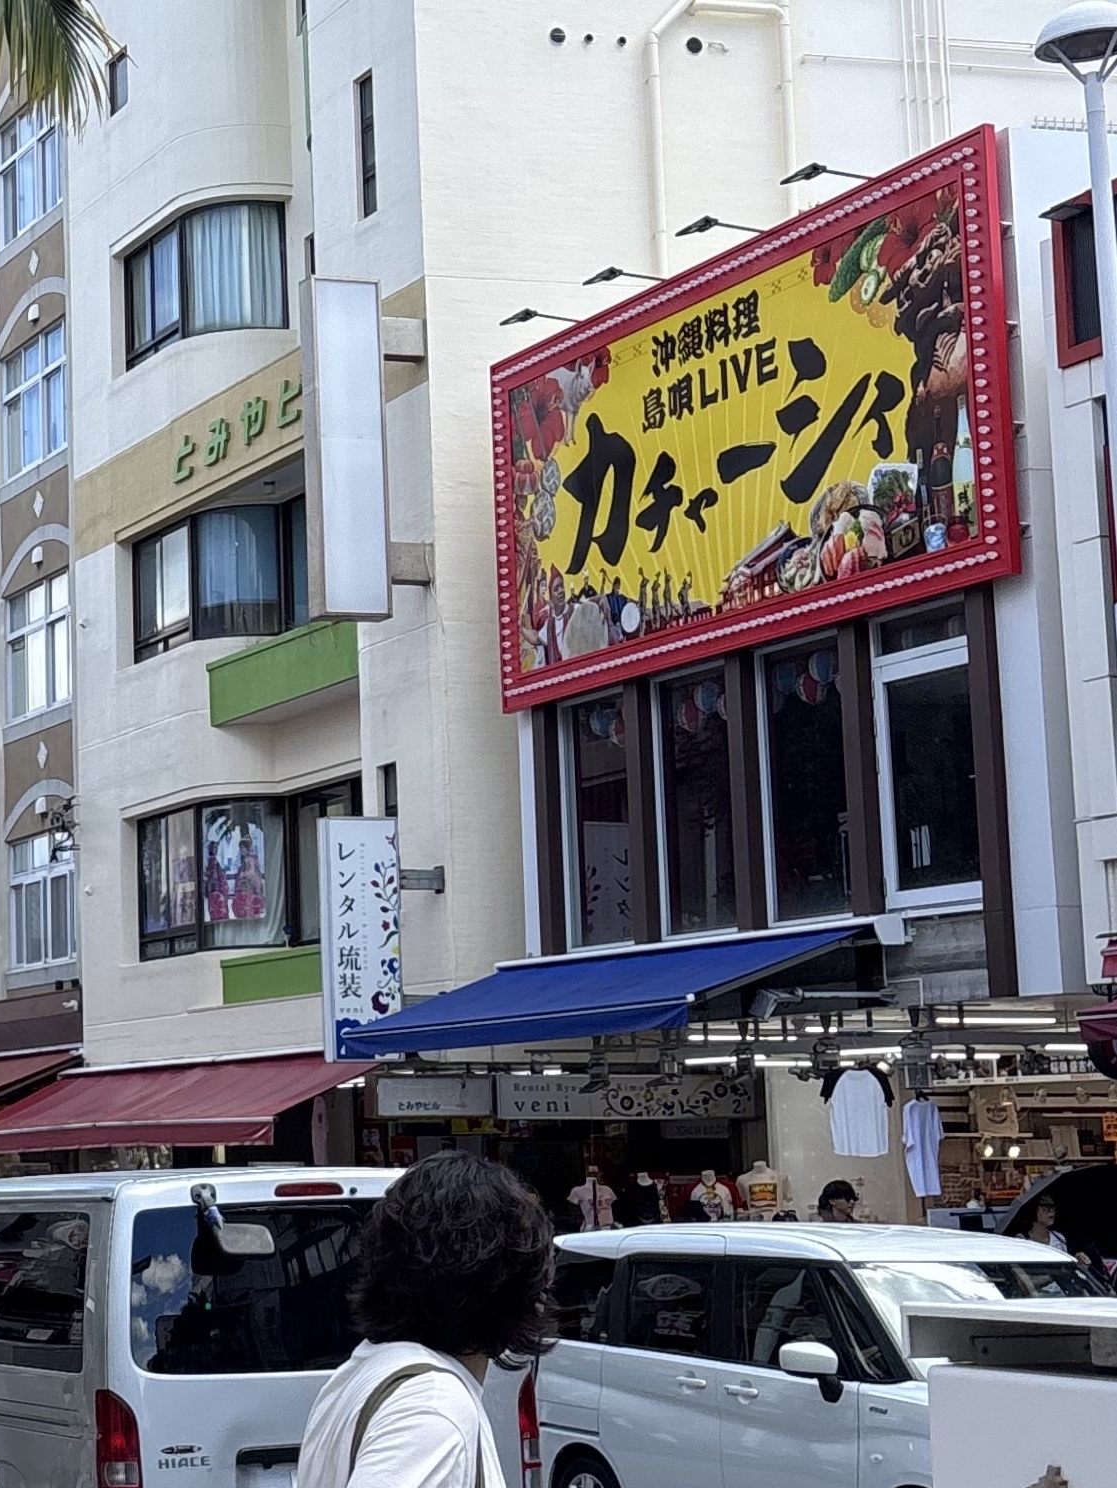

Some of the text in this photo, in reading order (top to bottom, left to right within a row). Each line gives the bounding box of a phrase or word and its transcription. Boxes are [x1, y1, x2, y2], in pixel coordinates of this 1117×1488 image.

[651, 288, 761, 378] 沖縄料理
[642, 336, 779, 434] 島唄LIVE
[337, 841, 362, 999] レンタル琉装
[513, 1083, 550, 1092] Rental
[513, 1095, 571, 1113] veni
[158, 1455, 211, 1470] HIACE
